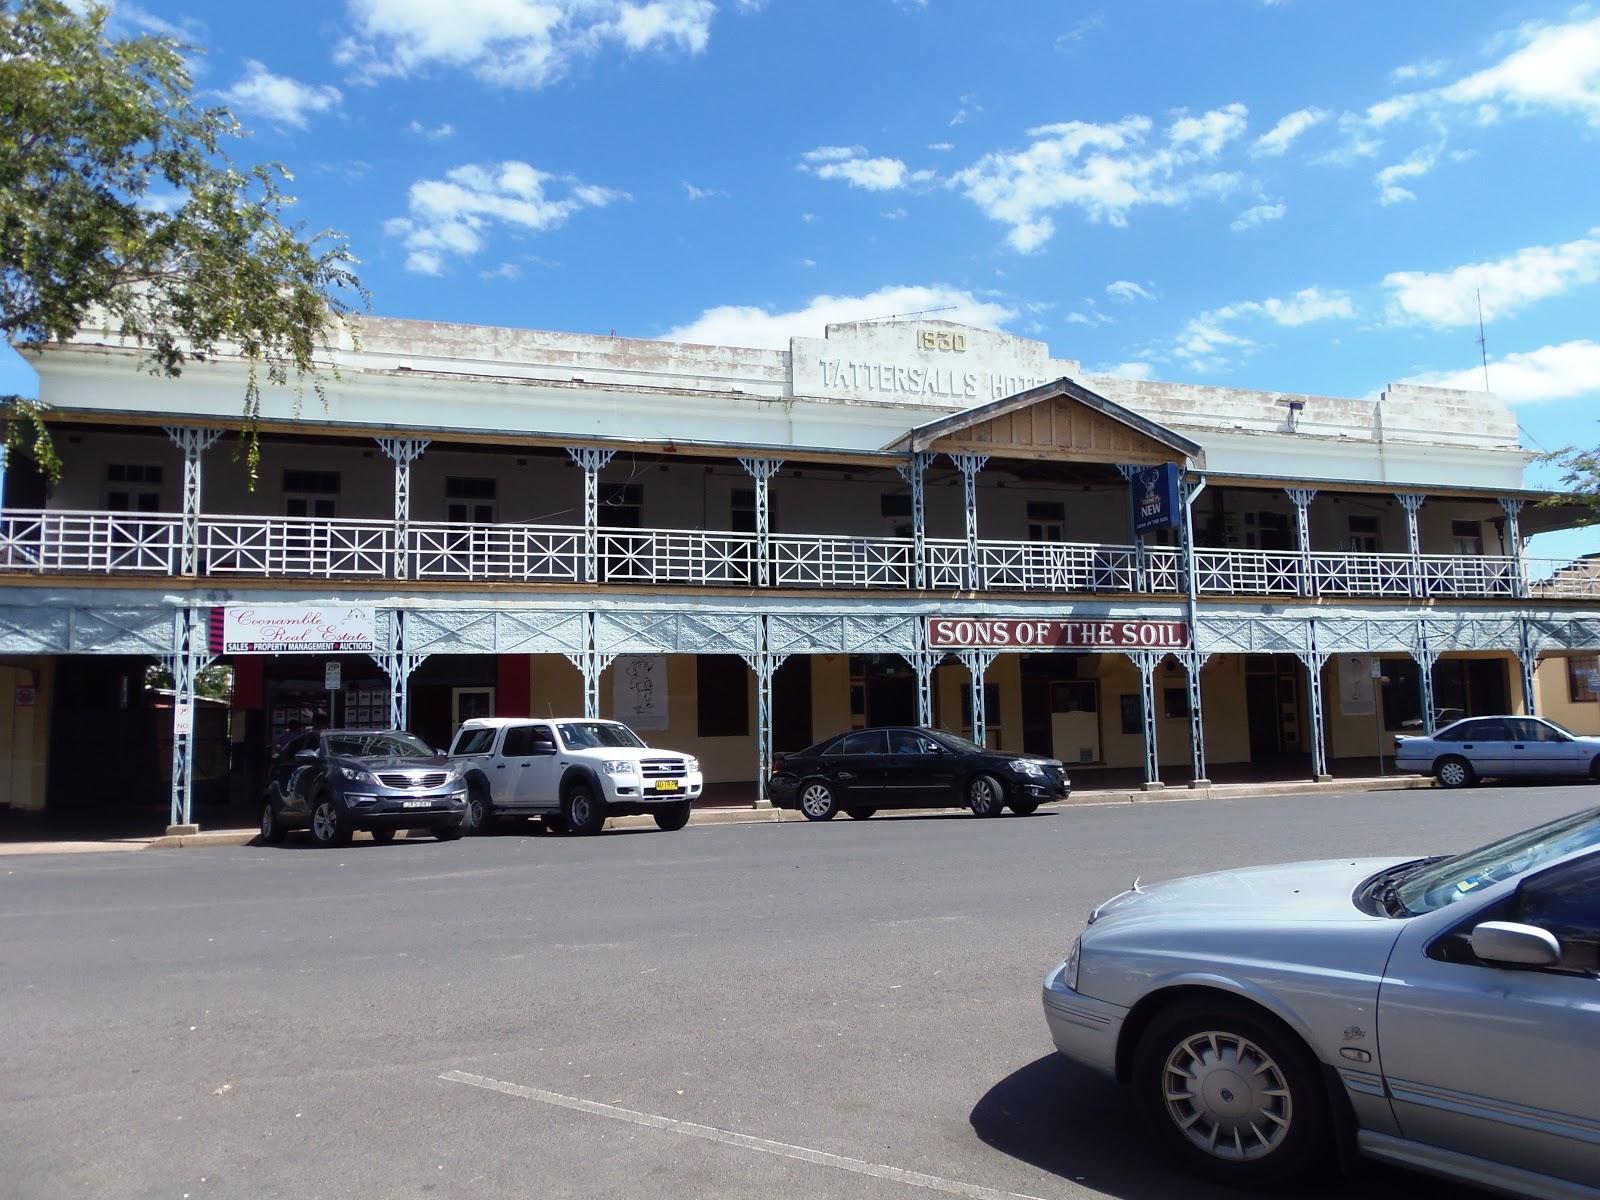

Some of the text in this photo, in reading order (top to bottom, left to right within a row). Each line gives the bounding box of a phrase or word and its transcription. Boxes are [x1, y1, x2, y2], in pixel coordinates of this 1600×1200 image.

[917, 329, 966, 352] 1930
[819, 359, 1047, 399] TATTERSALLS HOT
[1141, 502, 1161, 518] NEW
[229, 609, 323, 626] Coonamble
[260, 625, 368, 641] Real Estate
[937, 621, 1182, 646] SONS OF THE SOIL
[227, 642, 372, 651] SALES PROPERTY MANAGEMENT AUCTIONS
[327, 663, 340, 671] 2P
